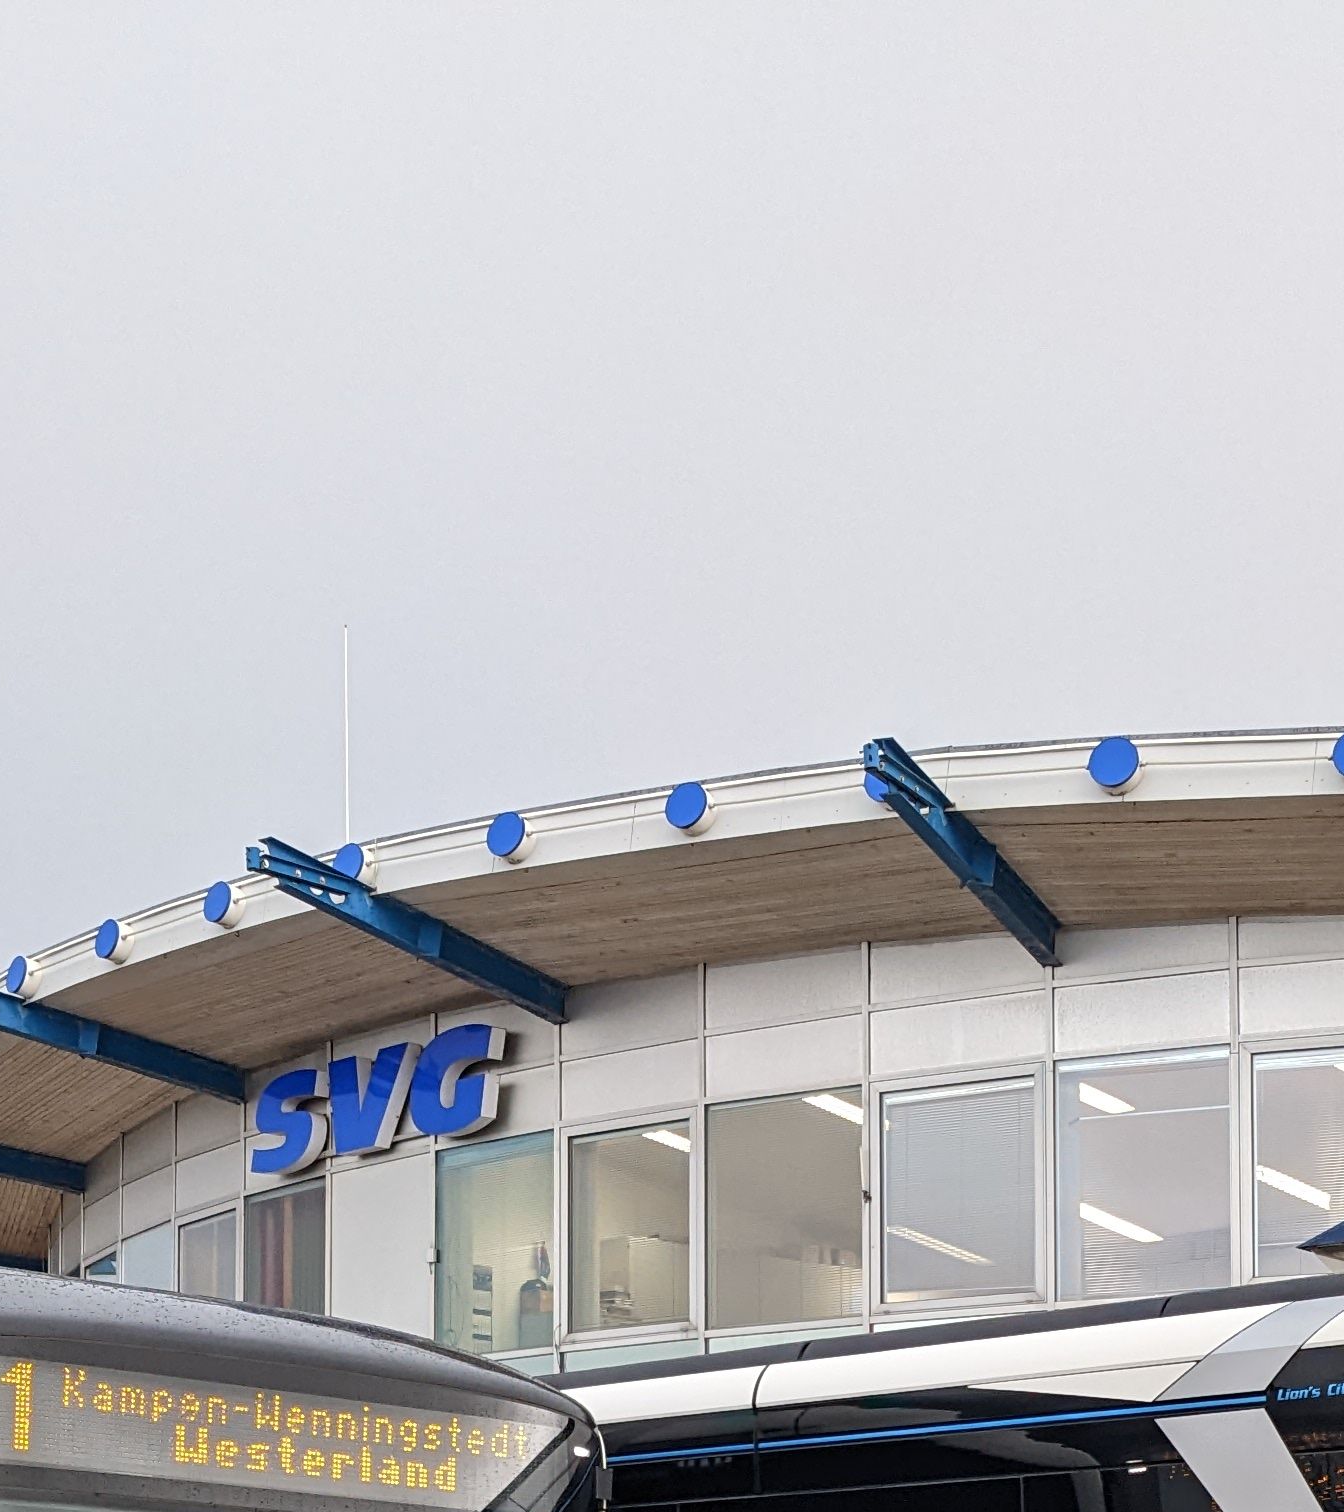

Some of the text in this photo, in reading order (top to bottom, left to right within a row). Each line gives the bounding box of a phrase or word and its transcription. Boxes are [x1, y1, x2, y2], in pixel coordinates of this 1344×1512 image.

[251, 1023, 505, 1176] SVG
[0, 1362, 34, 1452] 1
[60, 1364, 529, 1461] Kampen-Wenningstedt
[1277, 1385, 1321, 1401] Lion's
[173, 1424, 457, 1493] Westerland
